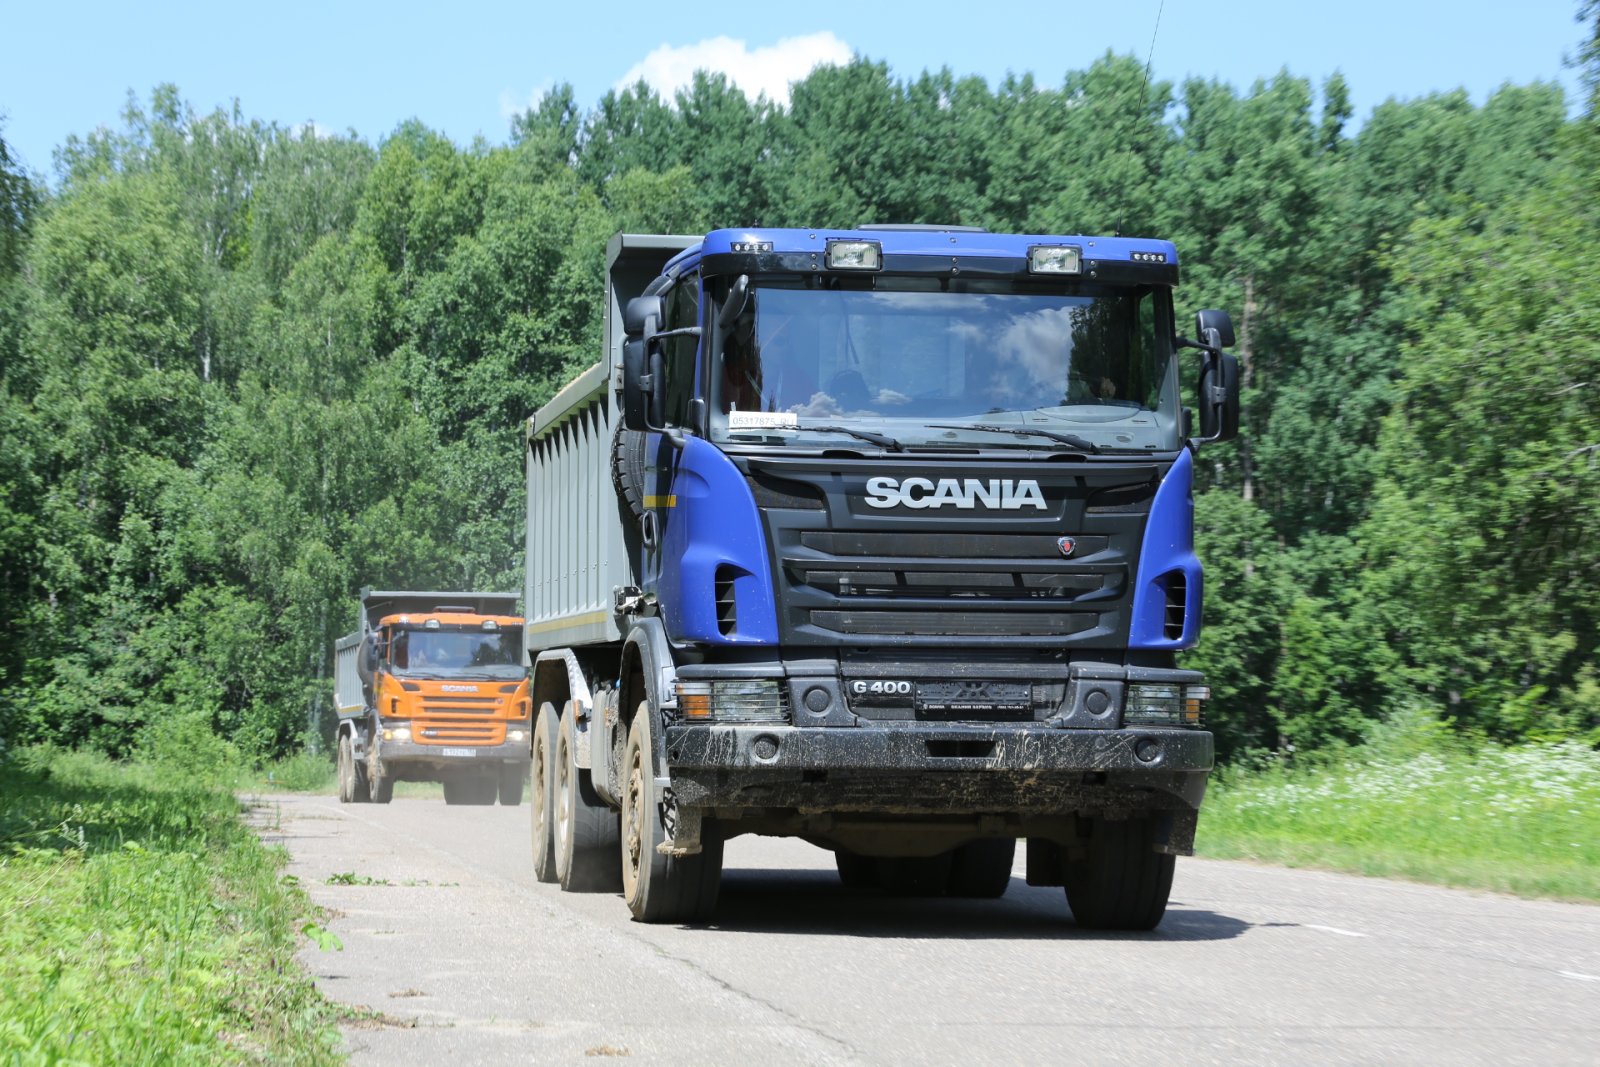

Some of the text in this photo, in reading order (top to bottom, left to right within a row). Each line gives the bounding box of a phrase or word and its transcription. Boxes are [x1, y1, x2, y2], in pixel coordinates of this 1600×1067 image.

[864, 476, 1048, 510] SCANIA
[853, 681, 911, 694] G 400
